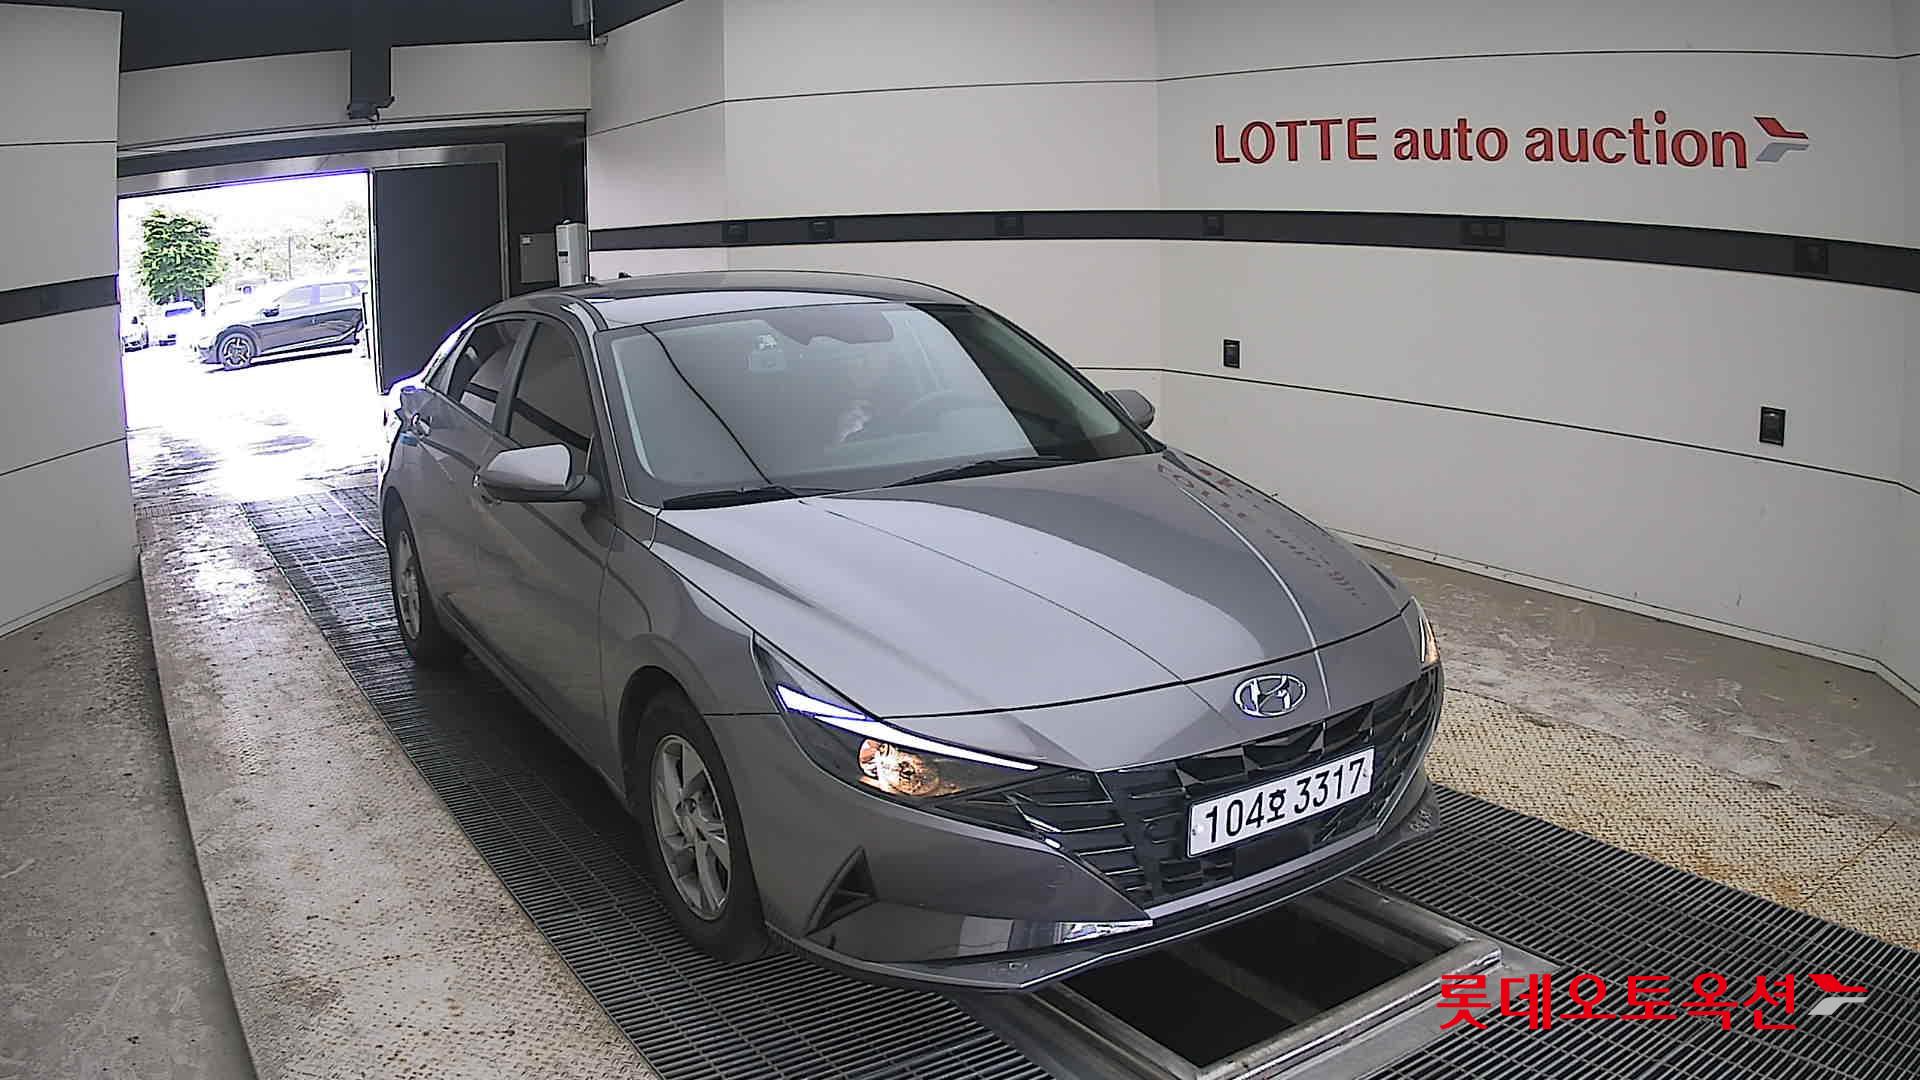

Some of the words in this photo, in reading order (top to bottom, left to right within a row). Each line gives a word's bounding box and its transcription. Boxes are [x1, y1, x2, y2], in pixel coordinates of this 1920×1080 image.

[1215, 117, 1378, 164] LOTTE
[1393, 117, 1509, 162] auto
[1524, 110, 1749, 169] auction
[1205, 789, 1287, 843] 104호
[1294, 757, 1365, 814] 3317
